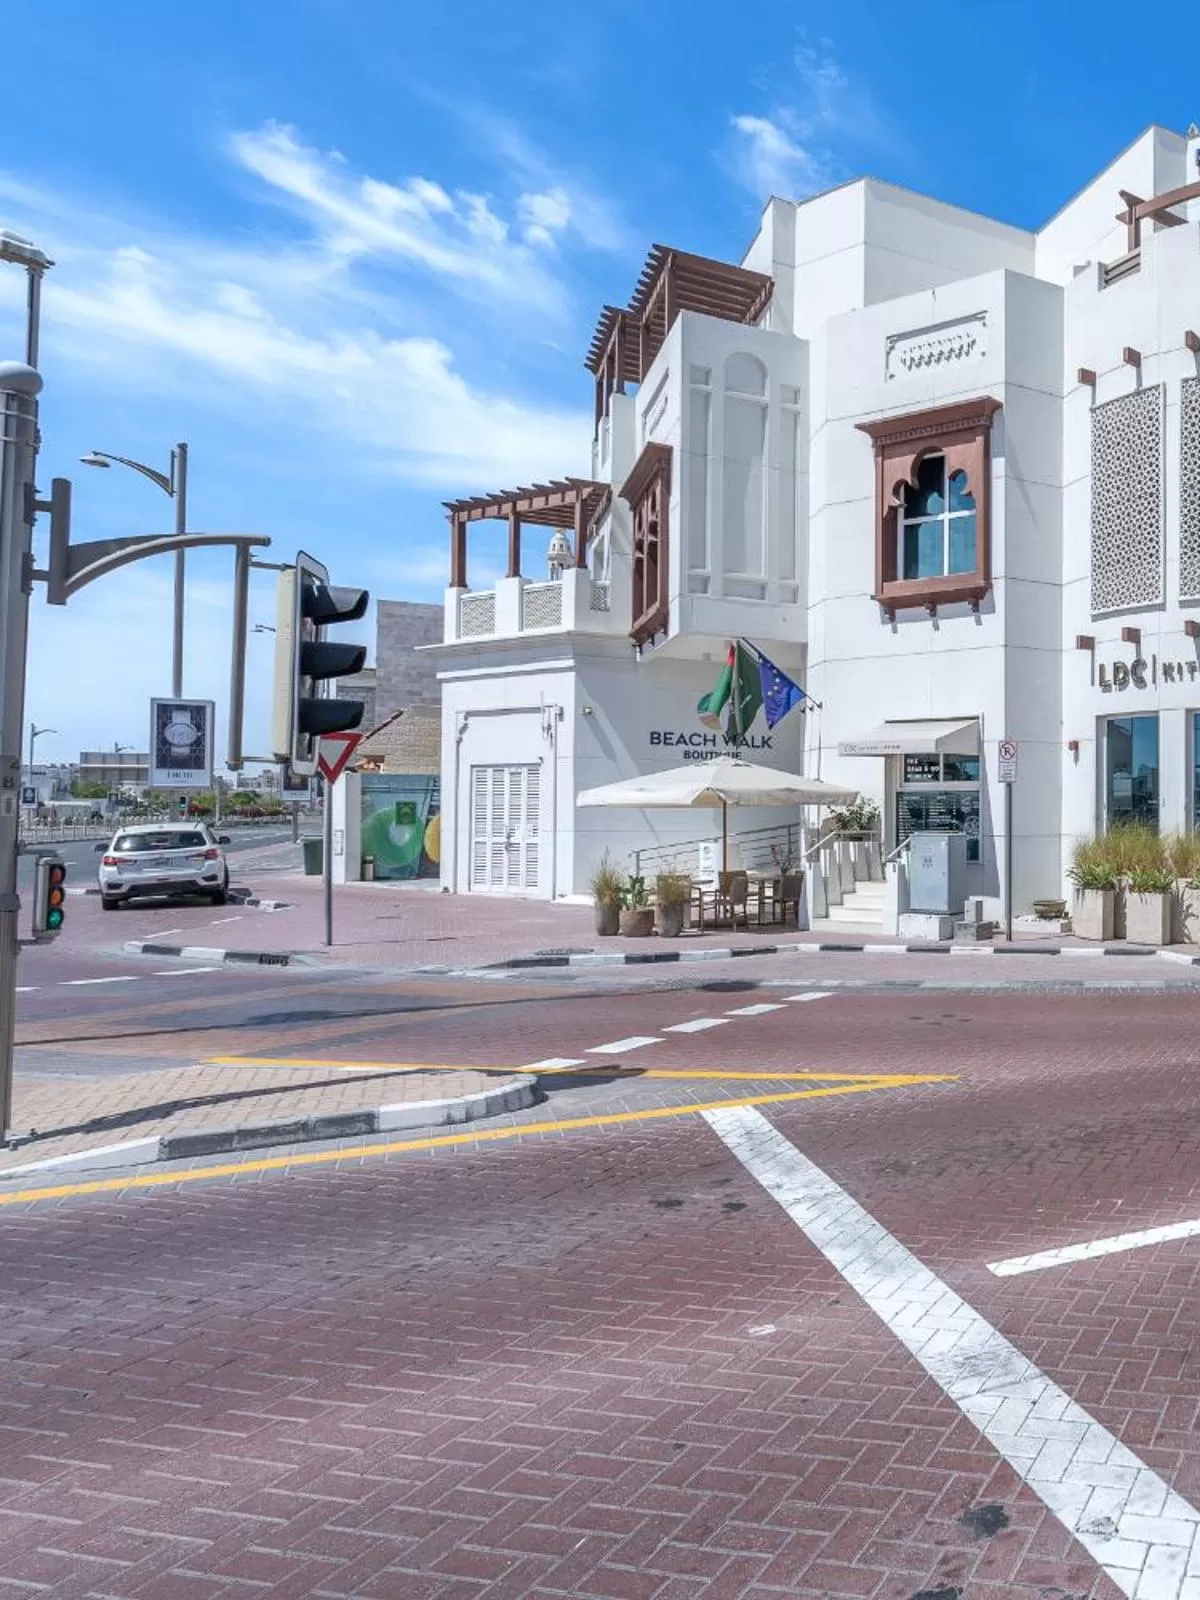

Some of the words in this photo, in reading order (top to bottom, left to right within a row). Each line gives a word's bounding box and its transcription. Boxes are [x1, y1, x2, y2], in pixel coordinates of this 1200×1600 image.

[1099, 659, 1148, 691] LDC
[650, 731, 716, 747] BEACH
[683, 750, 742, 761] BOUTIUE
